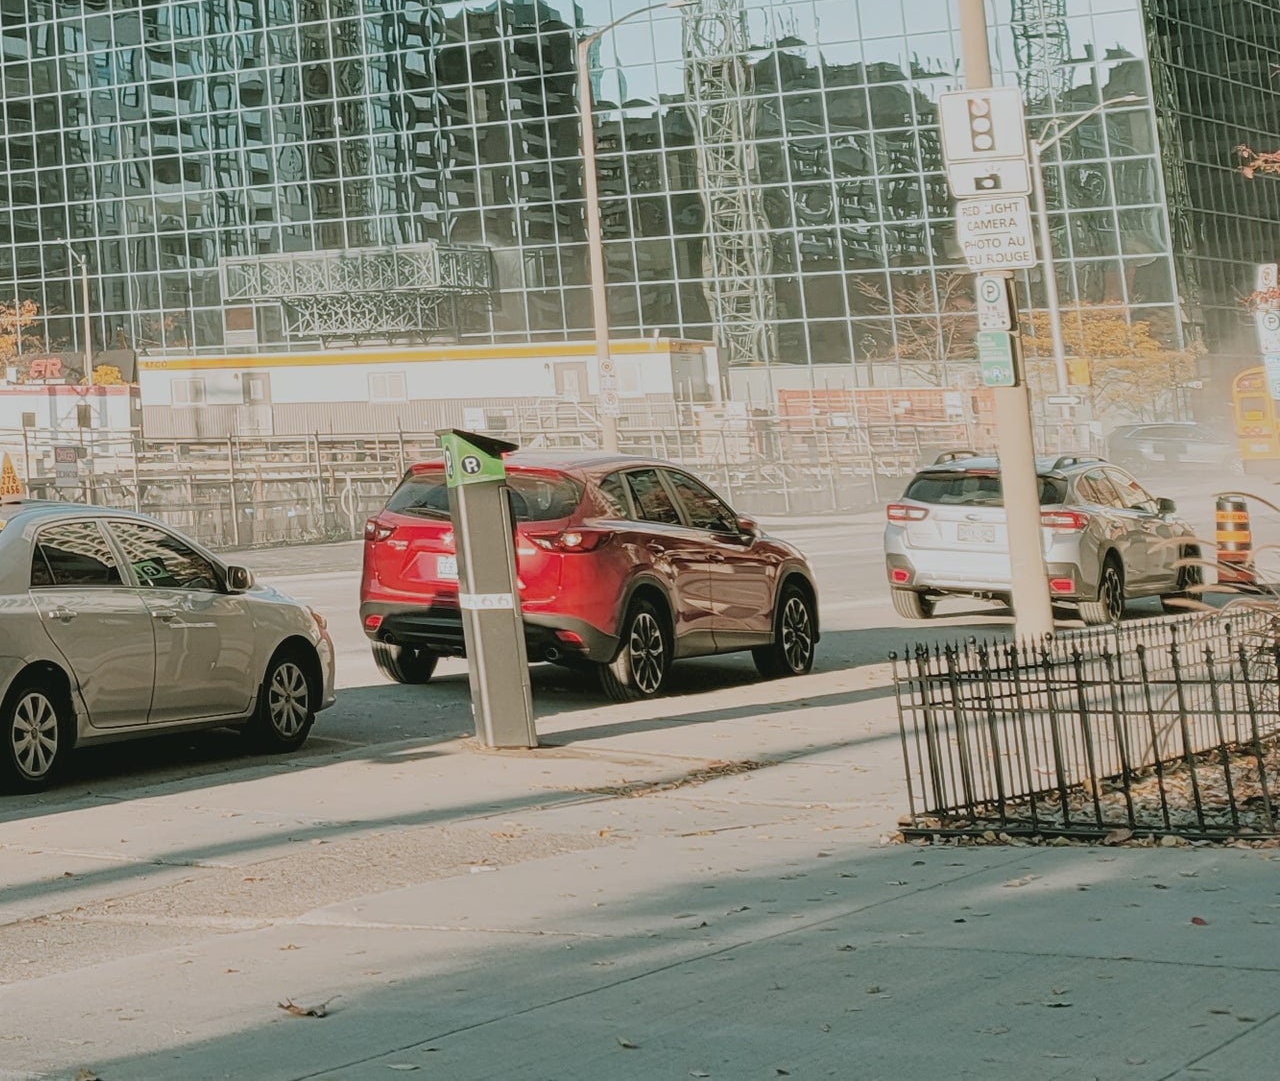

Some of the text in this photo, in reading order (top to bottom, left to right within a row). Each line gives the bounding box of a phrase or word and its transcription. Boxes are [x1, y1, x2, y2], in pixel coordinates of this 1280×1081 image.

[962, 206, 980, 217] RED
[968, 218, 1018, 231] CAMERA
[965, 236, 1026, 250] PHOTO AU
[986, 251, 1030, 263] ROUGE
[1, 476, 16, 485] 276
[0, 486, 20, 496] 0456
